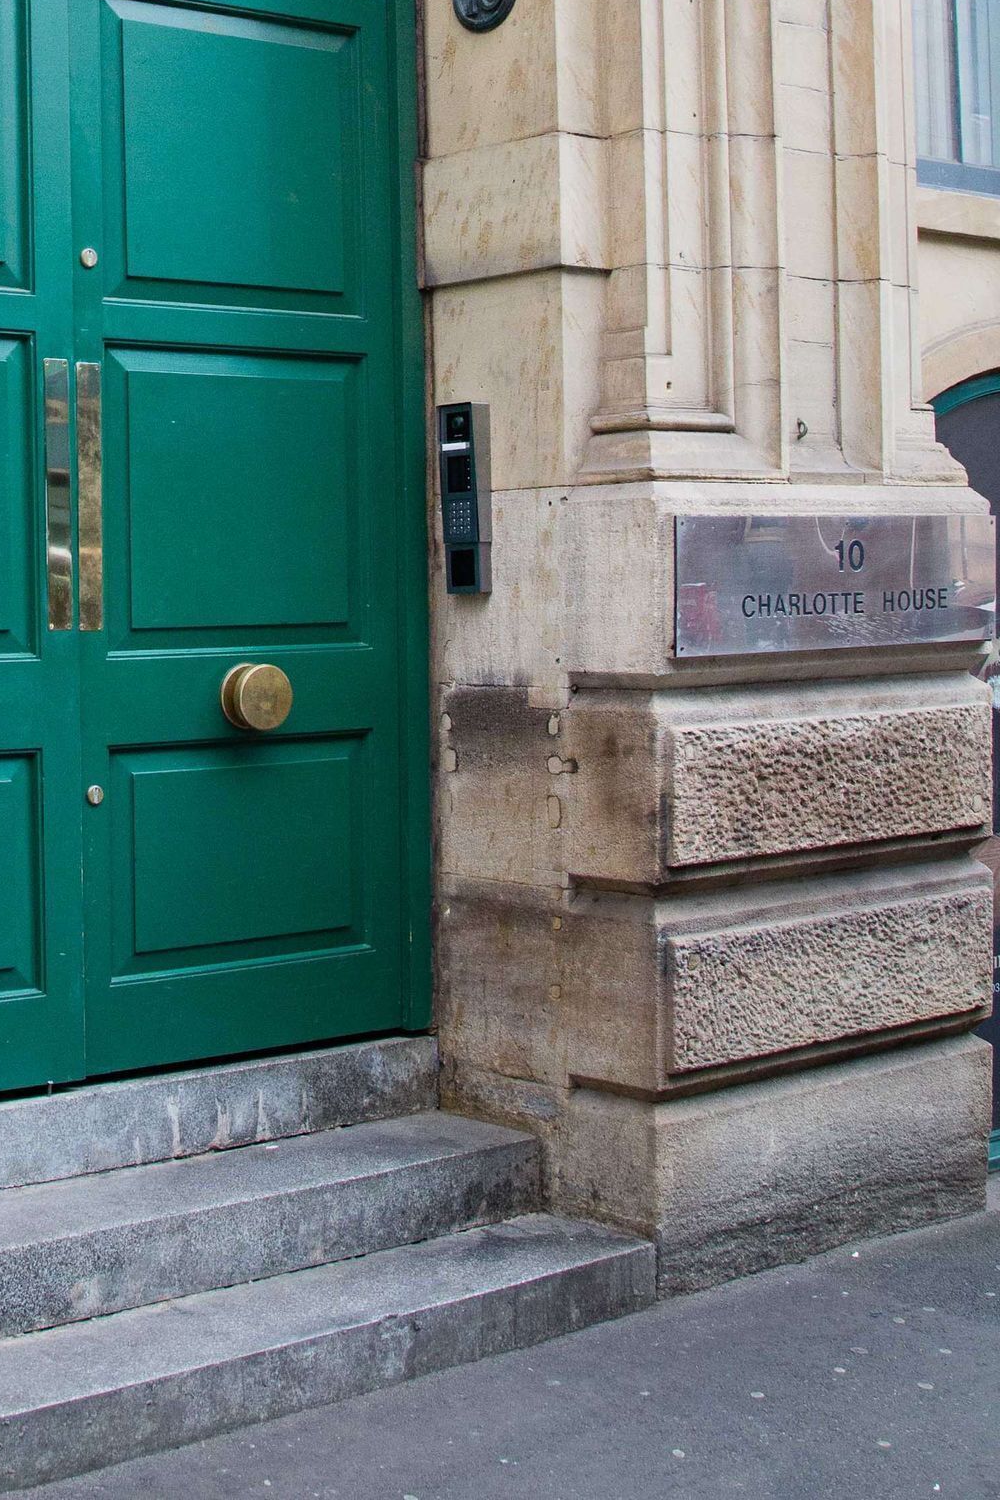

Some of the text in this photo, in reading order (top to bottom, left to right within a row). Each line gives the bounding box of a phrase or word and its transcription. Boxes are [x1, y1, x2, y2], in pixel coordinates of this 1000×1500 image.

[835, 539, 864, 572] 10
[741, 588, 948, 617] CHARLOTTE HOUSE
